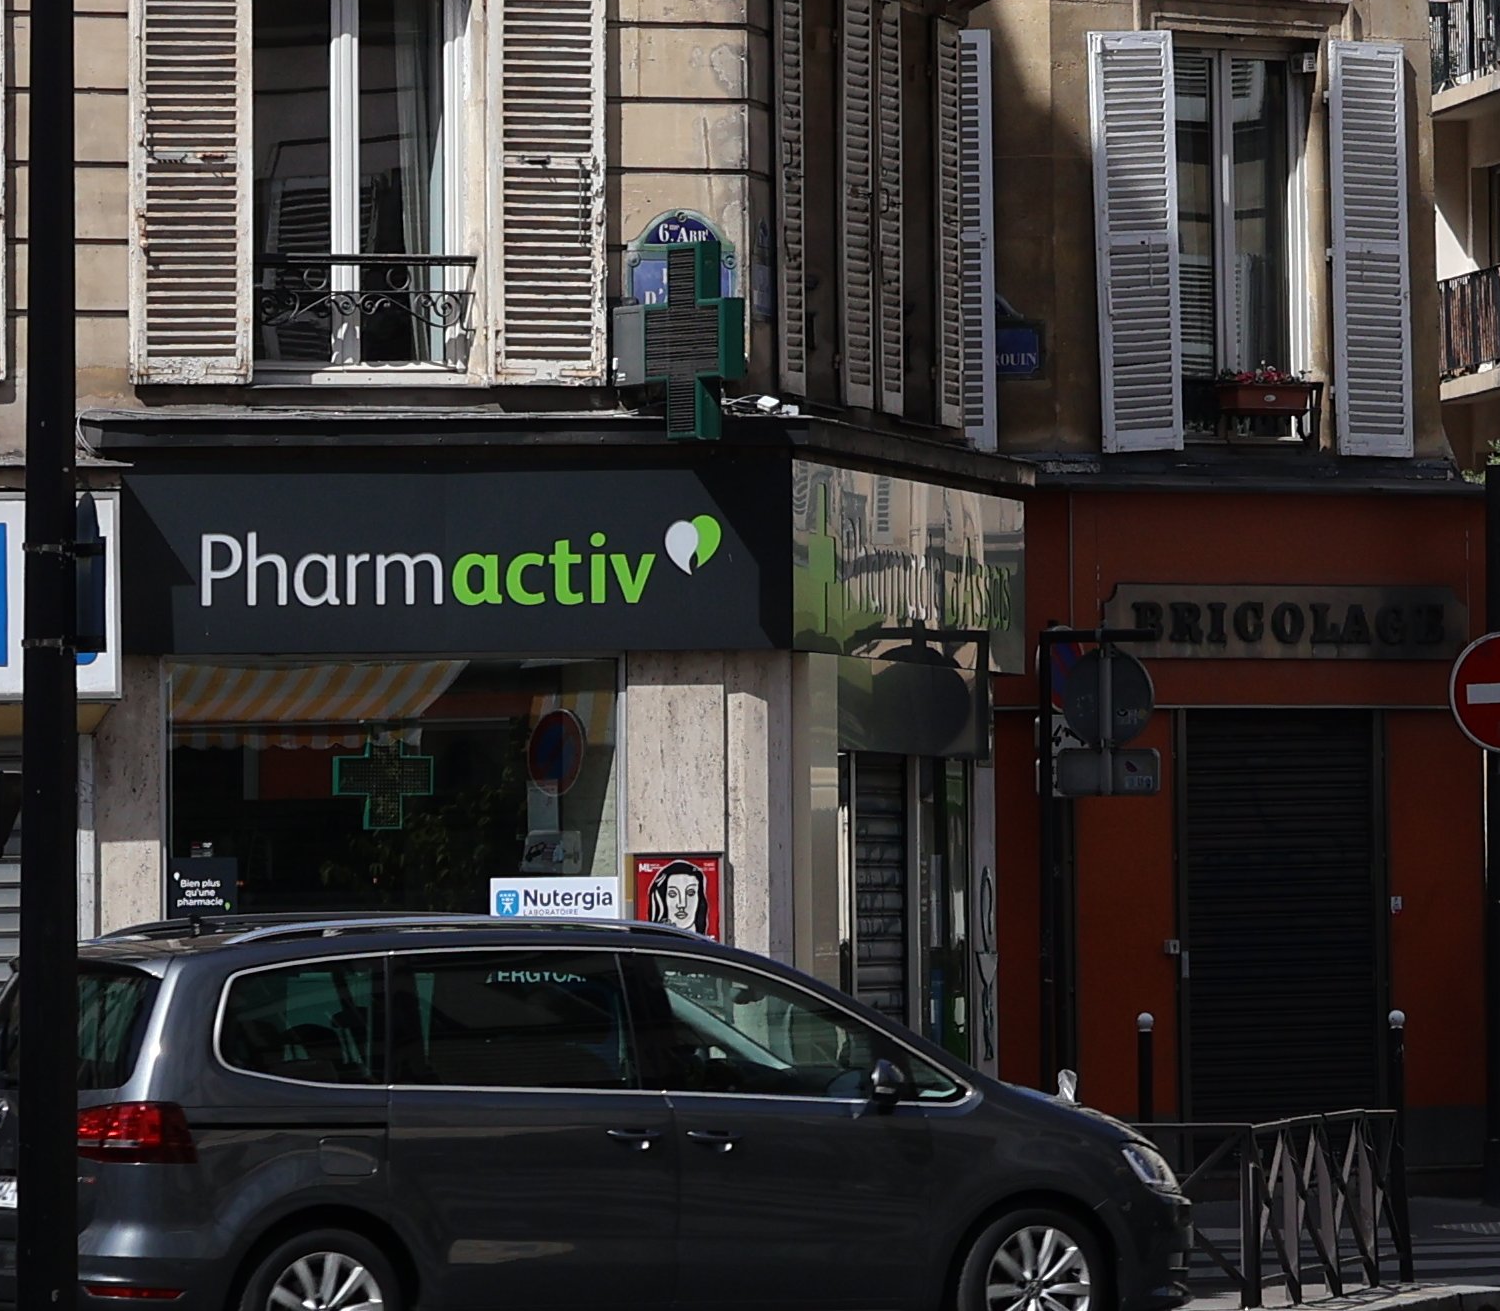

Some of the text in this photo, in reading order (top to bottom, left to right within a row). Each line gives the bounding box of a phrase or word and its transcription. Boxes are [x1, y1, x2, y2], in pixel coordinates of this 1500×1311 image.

[201, 531, 656, 606] Pharmactiv
[1132, 601, 1445, 645] BRICOLAGE
[180, 878, 221, 889] Bien plus
[185, 888, 216, 898] qu'une
[523, 885, 613, 911] Nutergia
[177, 897, 224, 907] pharmacie
[523, 908, 579, 917] LABORATOIRE
